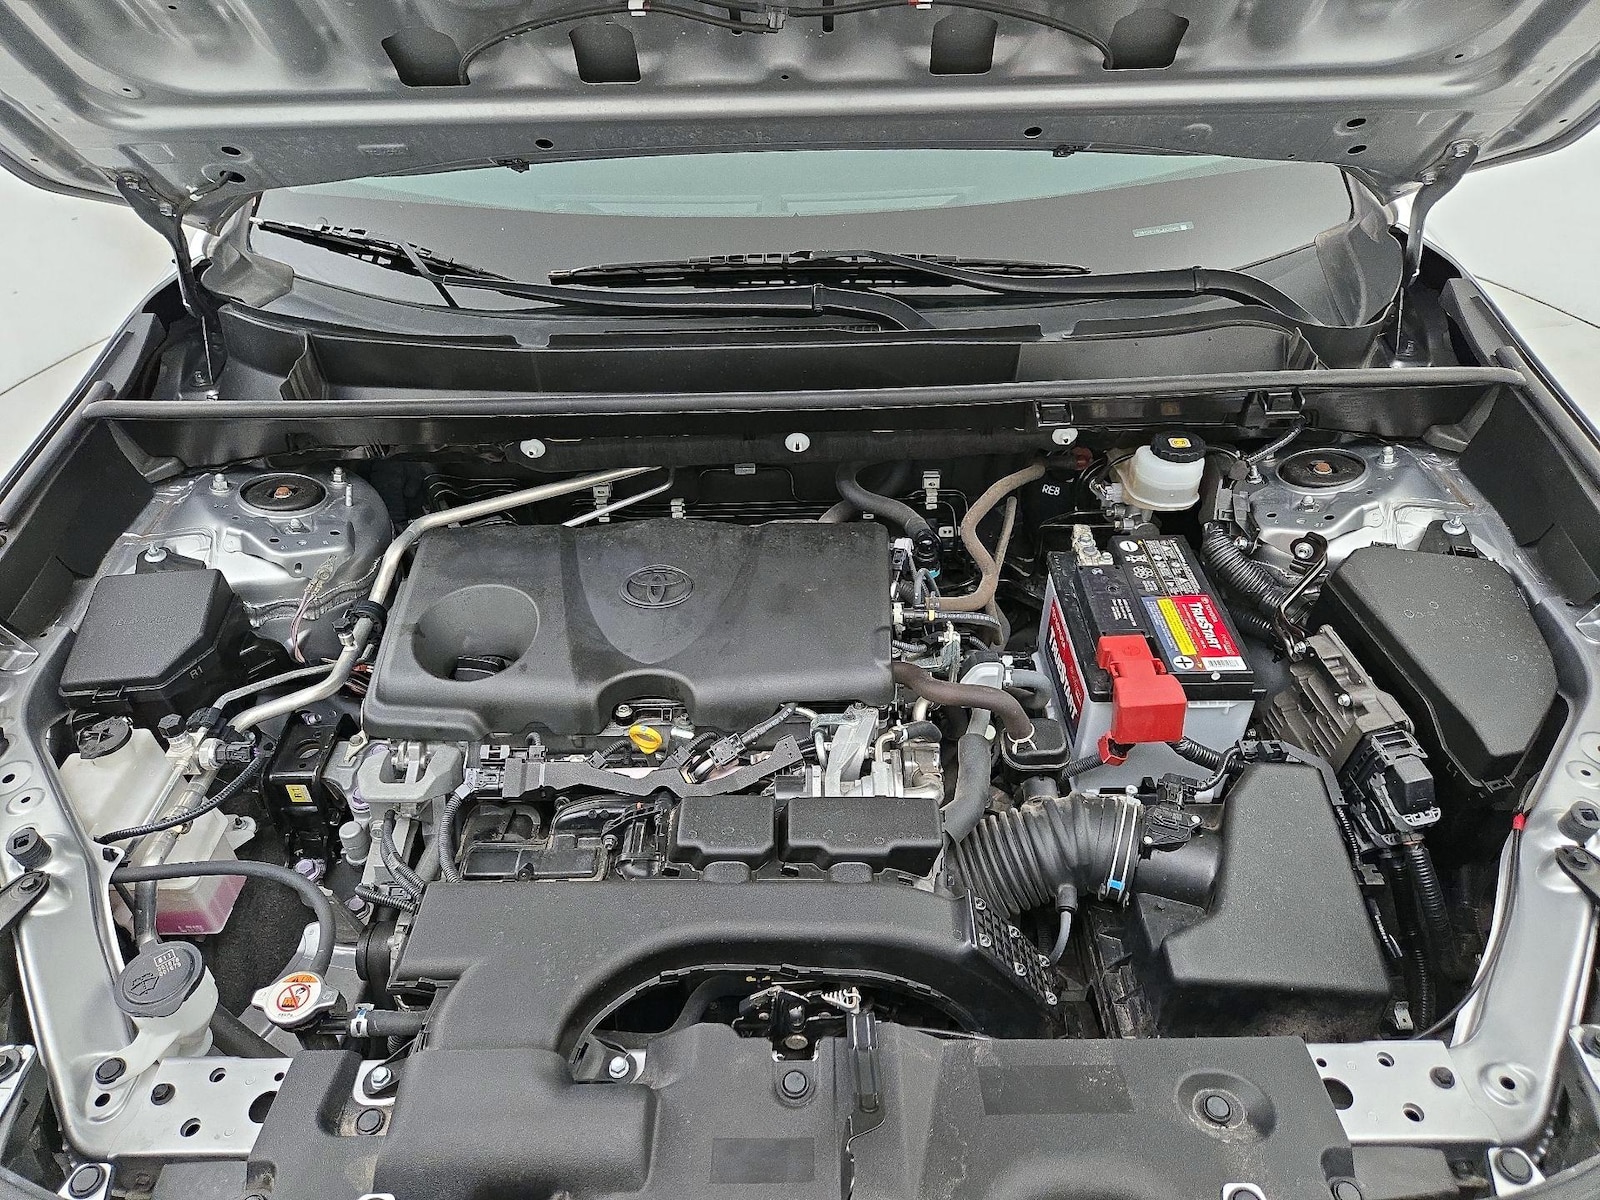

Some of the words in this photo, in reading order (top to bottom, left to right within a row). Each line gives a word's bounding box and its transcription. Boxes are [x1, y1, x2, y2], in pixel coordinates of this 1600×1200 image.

[1041, 484, 1061, 496] RE8
[1204, 603, 1219, 624] TOYOTA
[189, 665, 204, 680] R1
